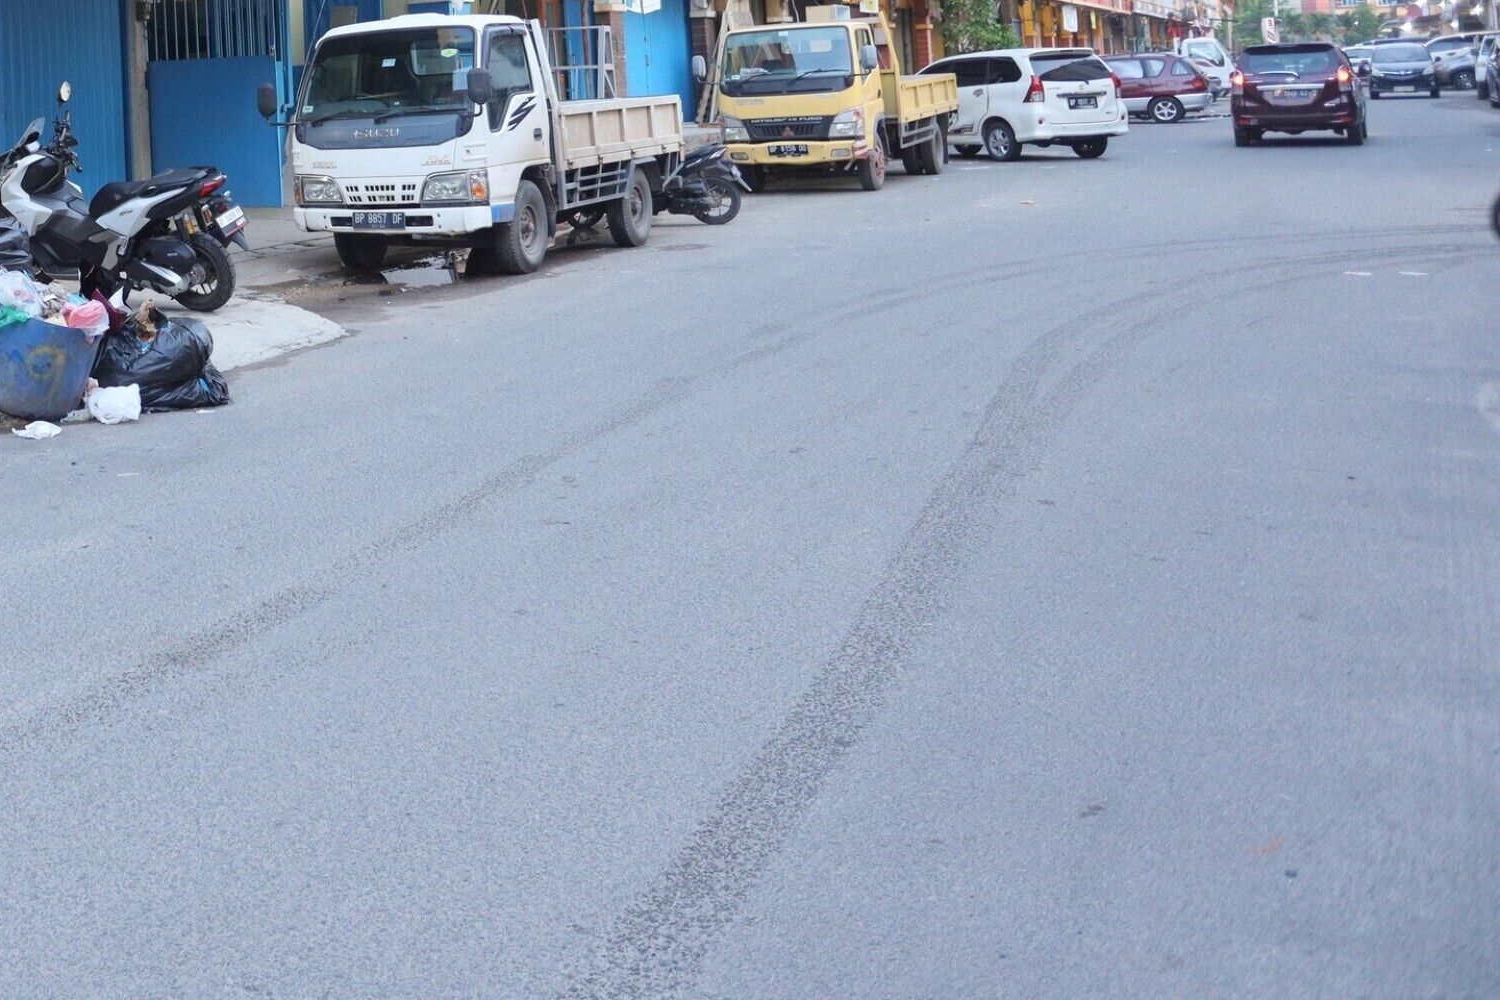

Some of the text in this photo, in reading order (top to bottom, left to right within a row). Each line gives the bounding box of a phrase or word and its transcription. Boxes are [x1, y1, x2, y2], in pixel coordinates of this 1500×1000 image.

[354, 213, 403, 224] BP 8857 DF
